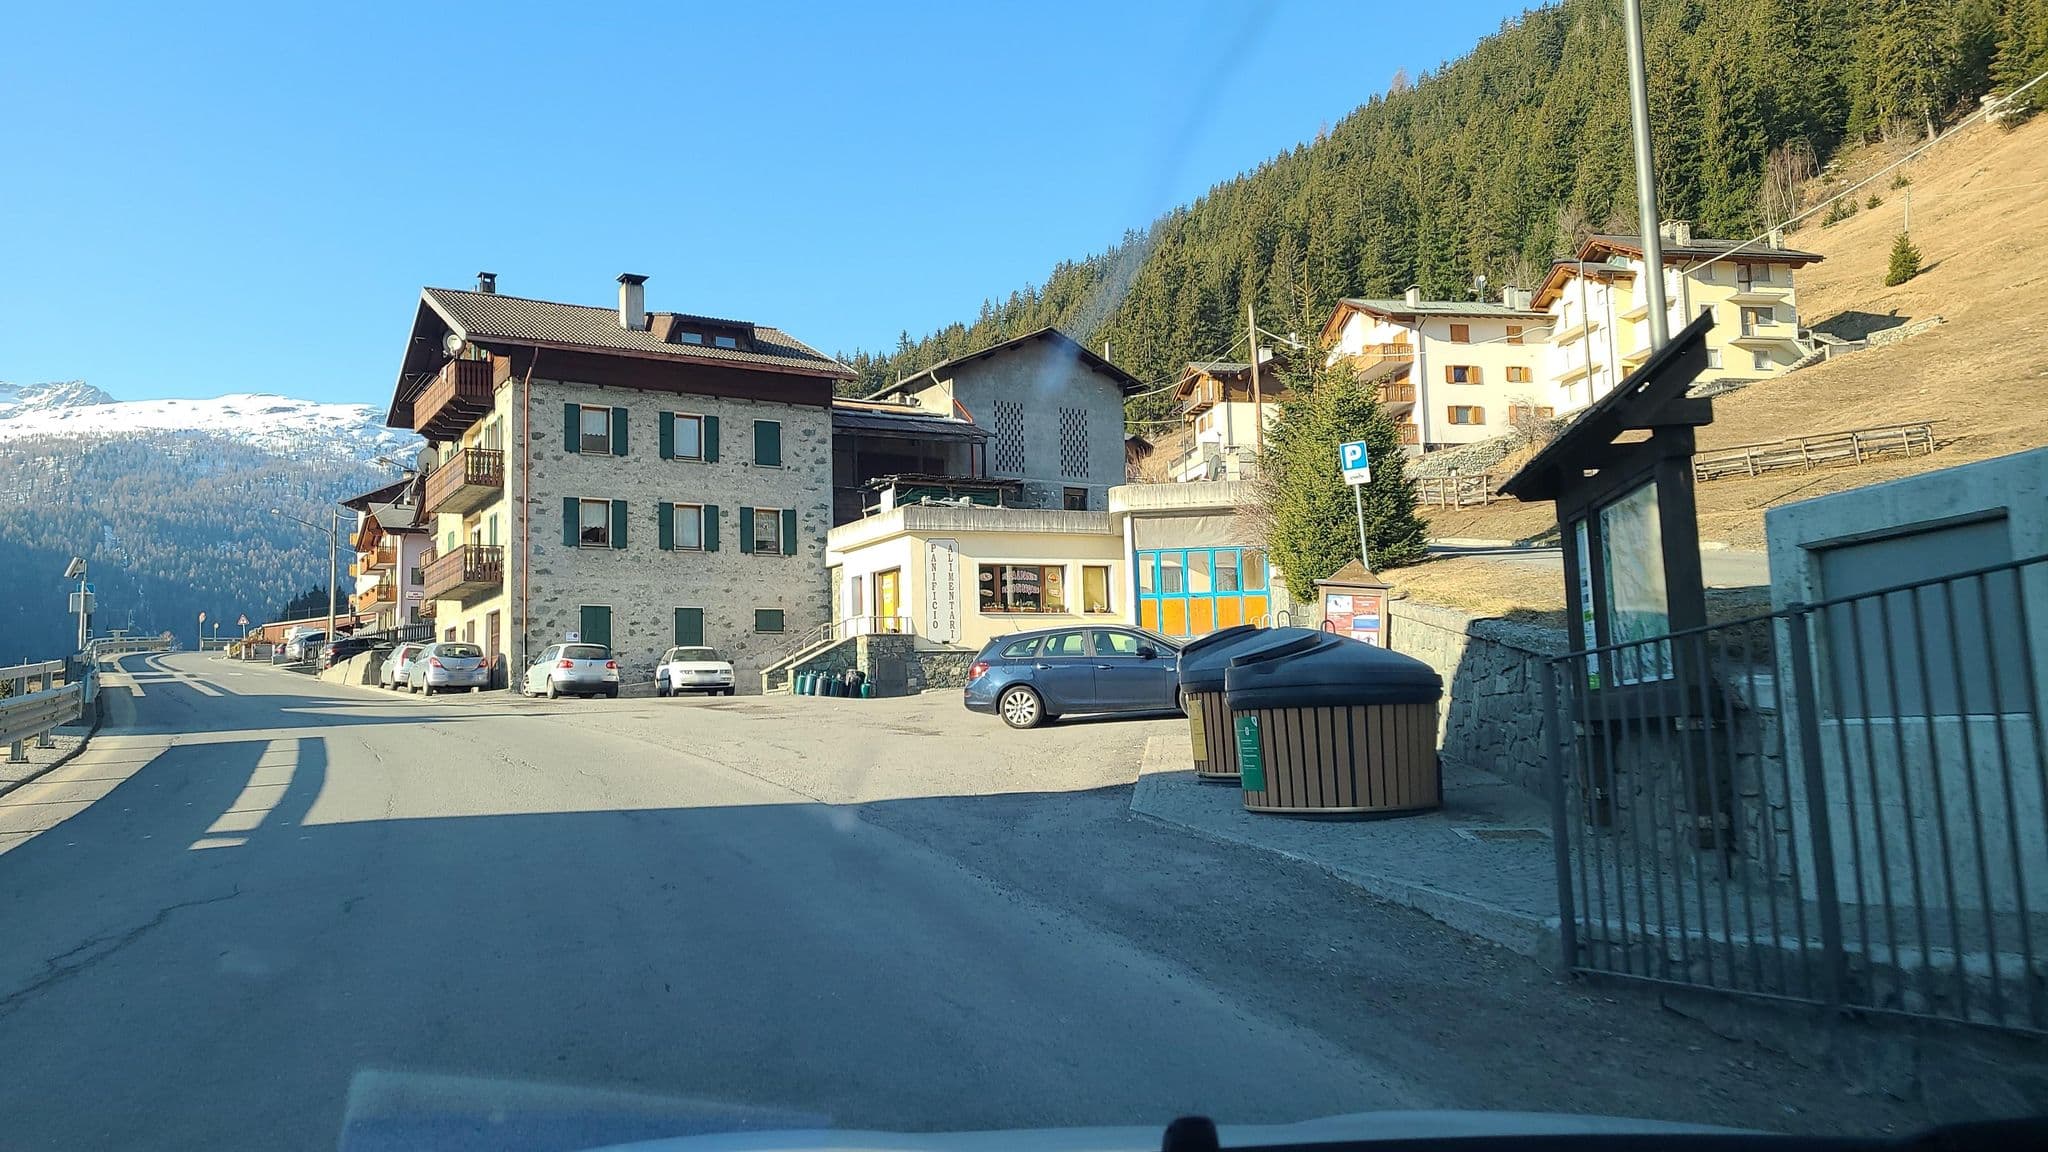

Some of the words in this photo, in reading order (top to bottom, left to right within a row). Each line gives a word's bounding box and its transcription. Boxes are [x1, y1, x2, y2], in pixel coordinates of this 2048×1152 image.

[1344, 445, 1362, 469] P
[931, 543, 939, 629] PANIFICIO
[947, 543, 955, 639] ALIMENTARI
